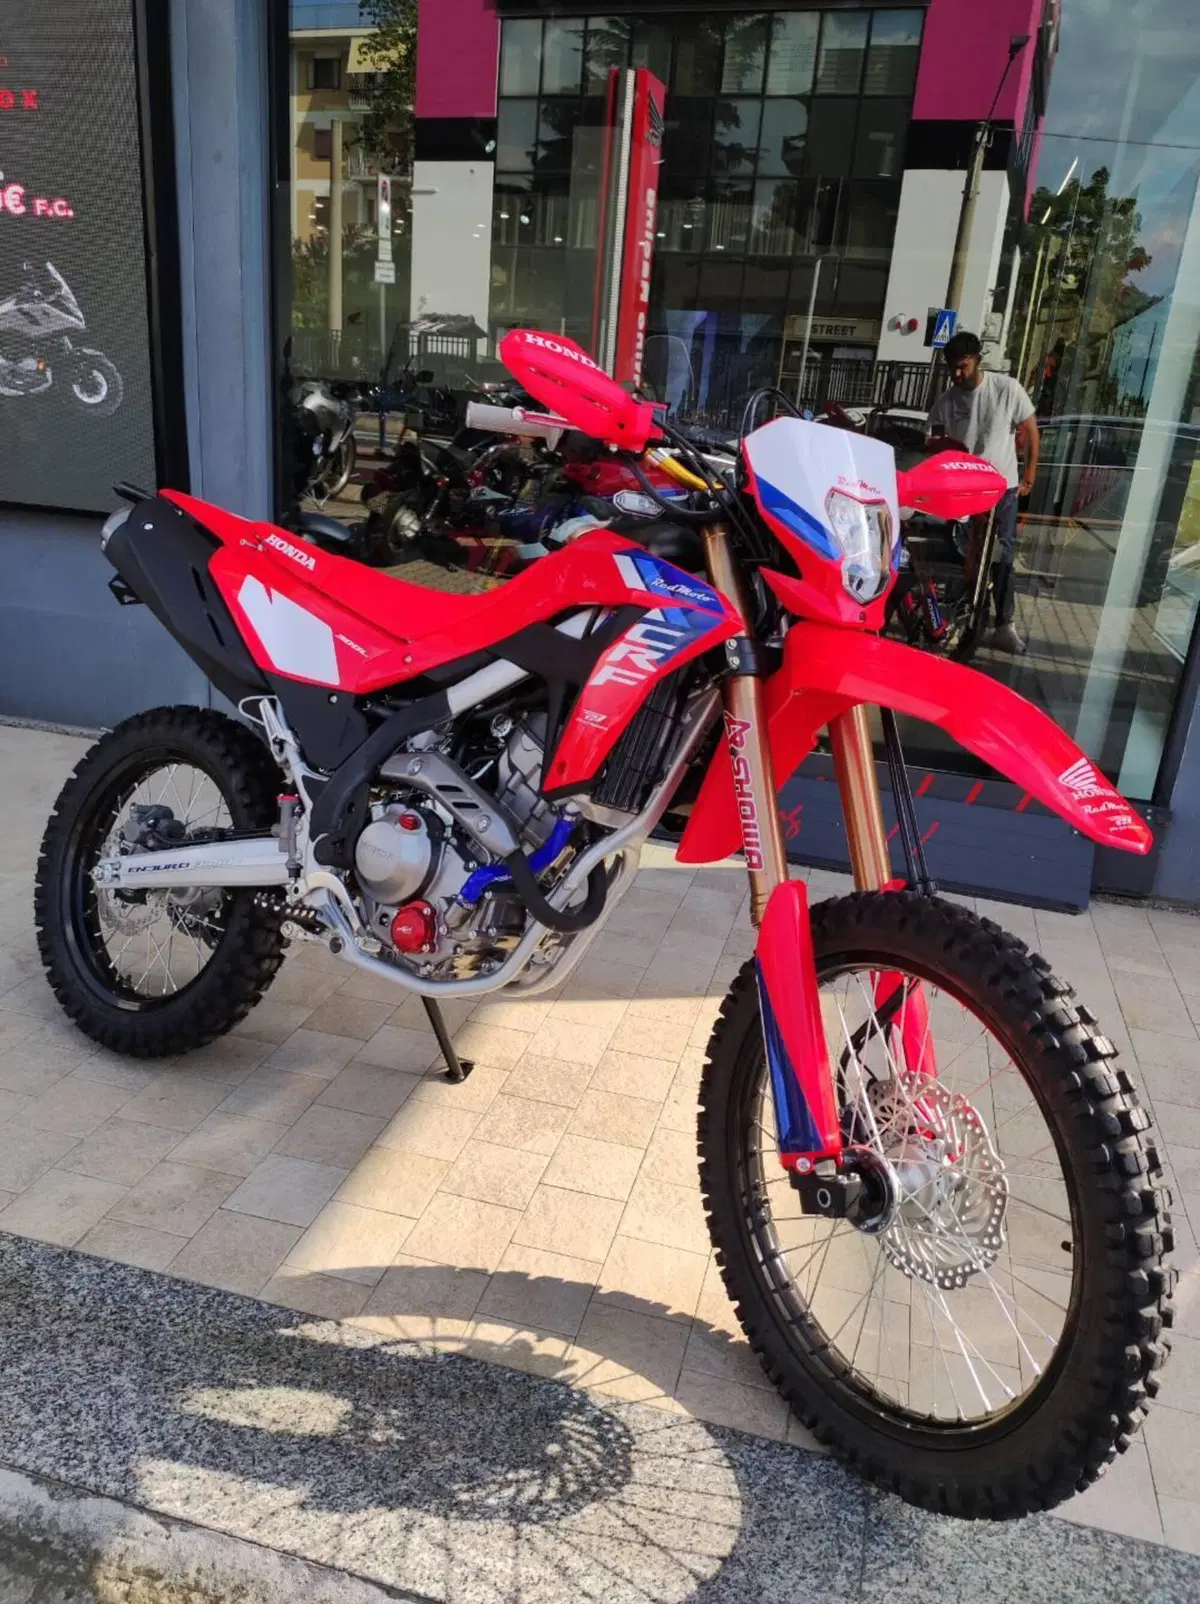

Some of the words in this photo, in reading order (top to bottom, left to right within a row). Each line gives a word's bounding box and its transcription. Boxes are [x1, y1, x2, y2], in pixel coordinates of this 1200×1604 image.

[811, 323, 857, 336] STREET
[940, 461, 998, 474] HONDA
[265, 533, 317, 571] HONDA
[650, 577, 717, 602] RedMoto
[588, 622, 686, 687] CRF
[731, 755, 764, 872] SHOWA
[128, 862, 190, 873] ENDURO
